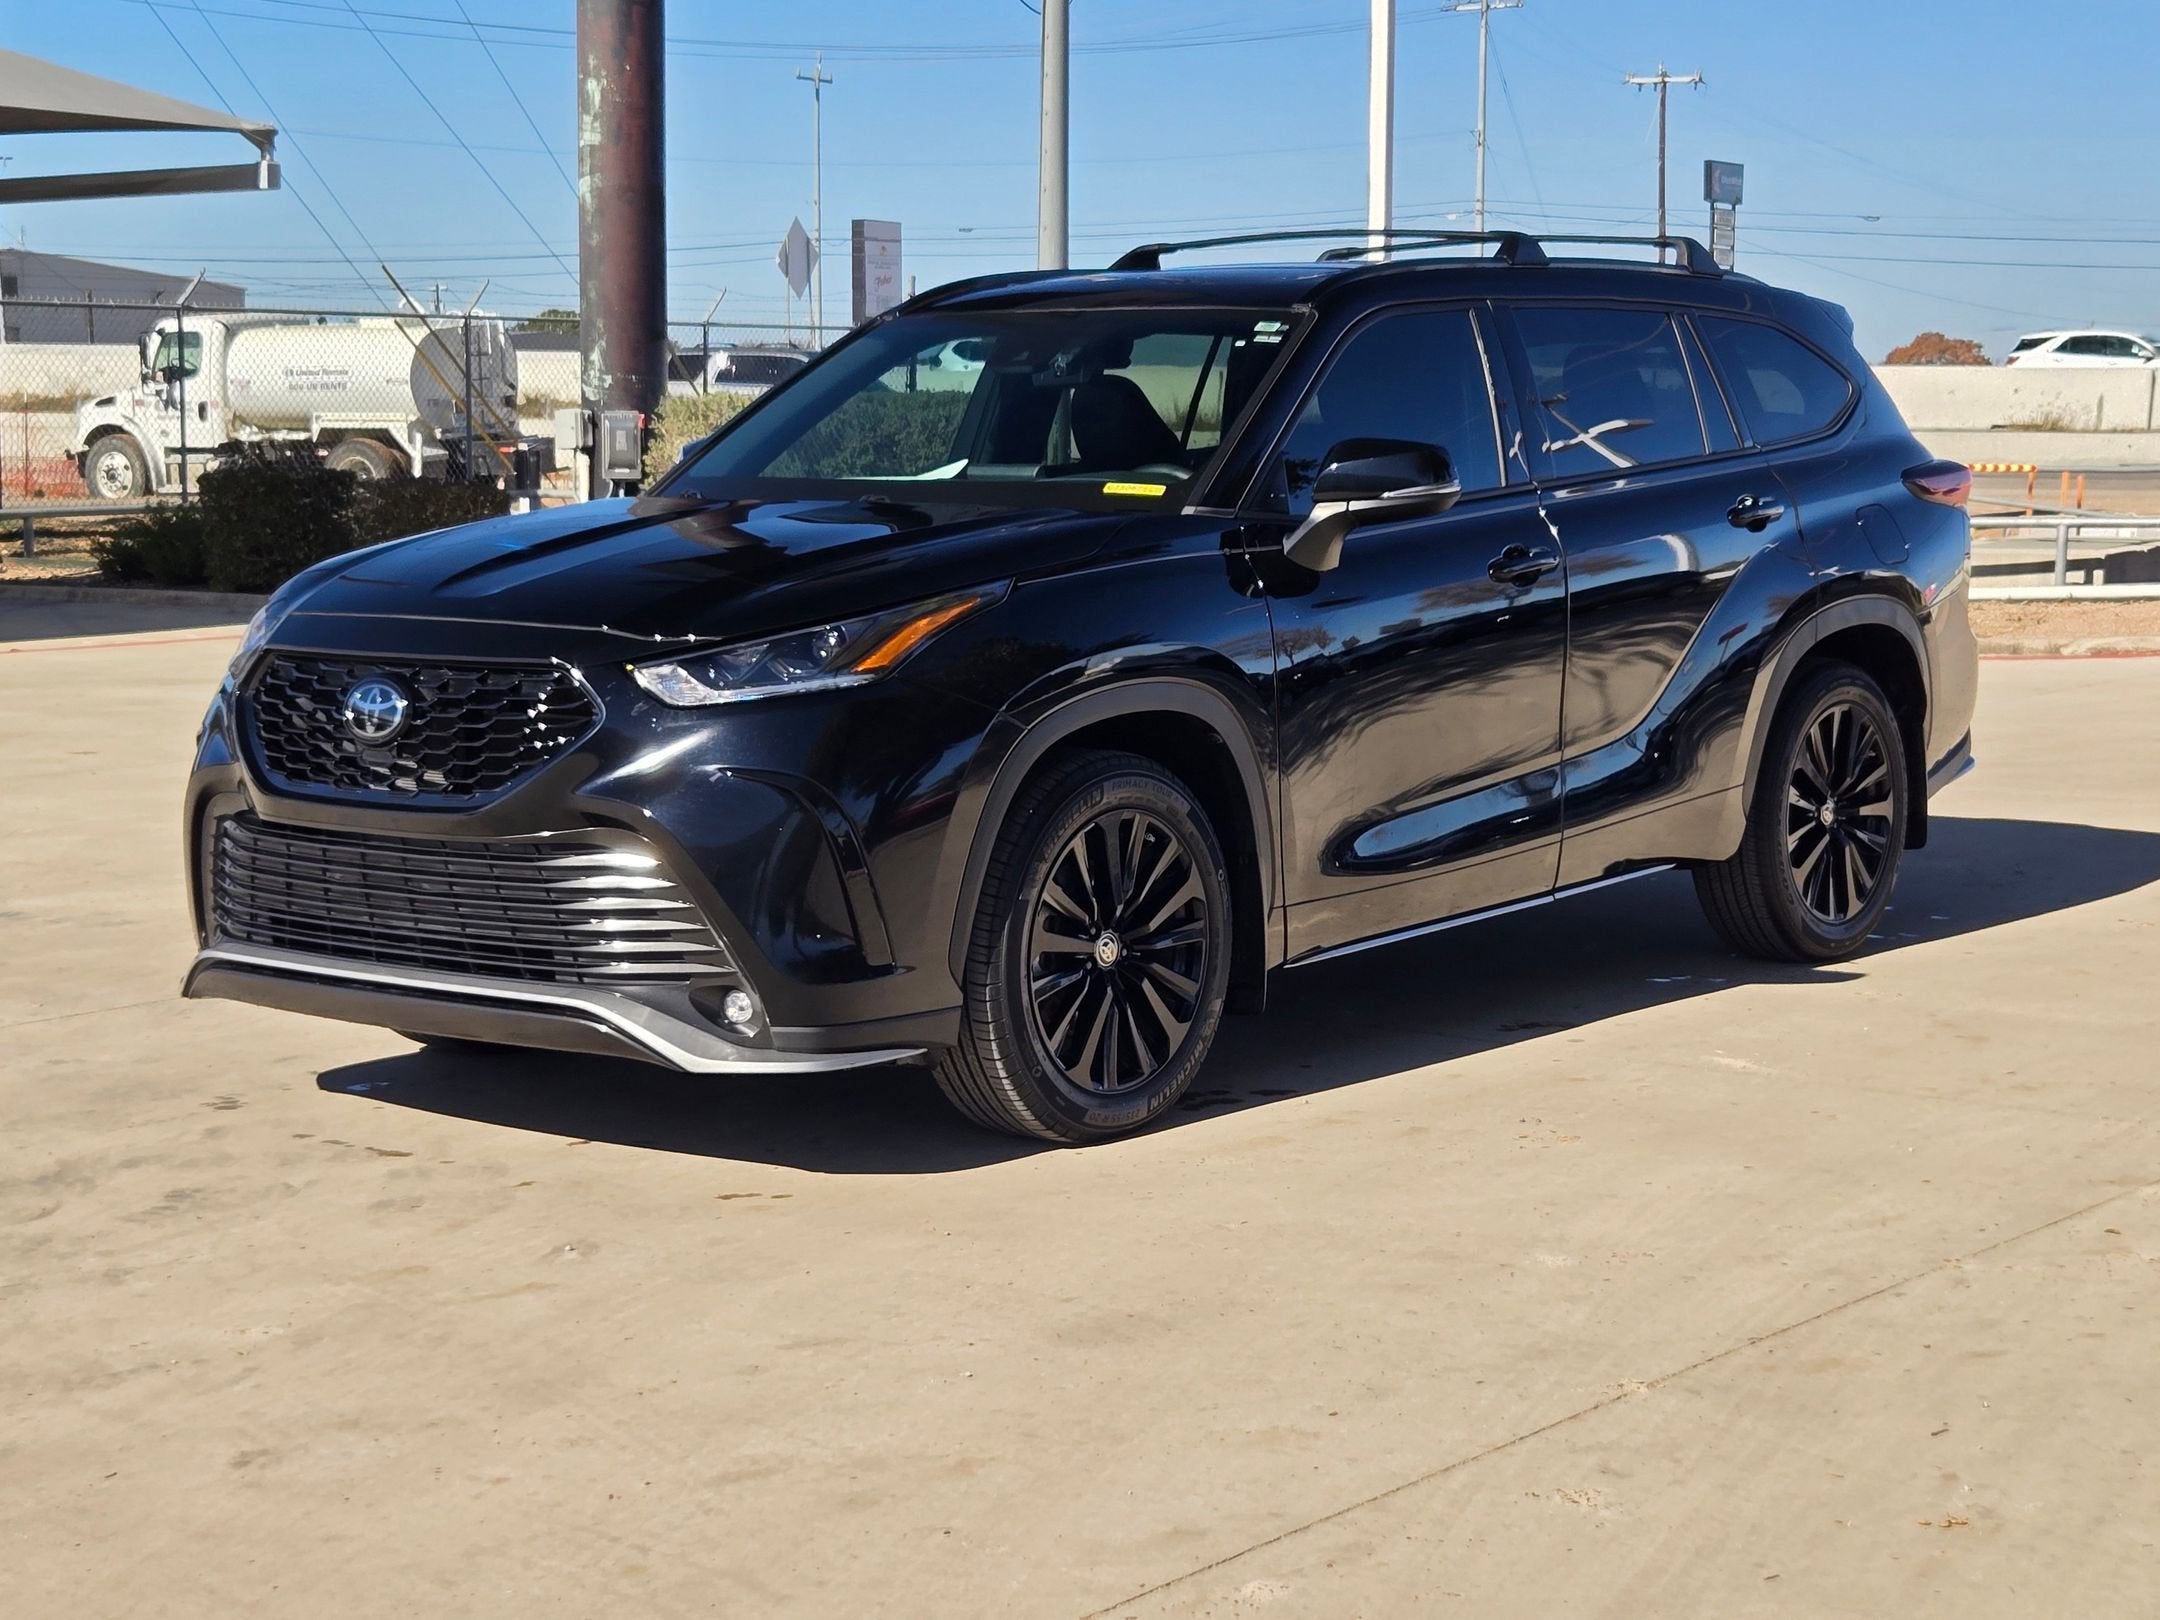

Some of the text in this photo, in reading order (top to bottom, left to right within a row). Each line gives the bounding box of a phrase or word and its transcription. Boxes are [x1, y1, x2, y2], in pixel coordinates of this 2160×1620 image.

[1111, 778, 1149, 792] PRIMACY
[1151, 781, 1174, 798] TOUR
[1149, 1039, 1204, 1110] MICHELIN
